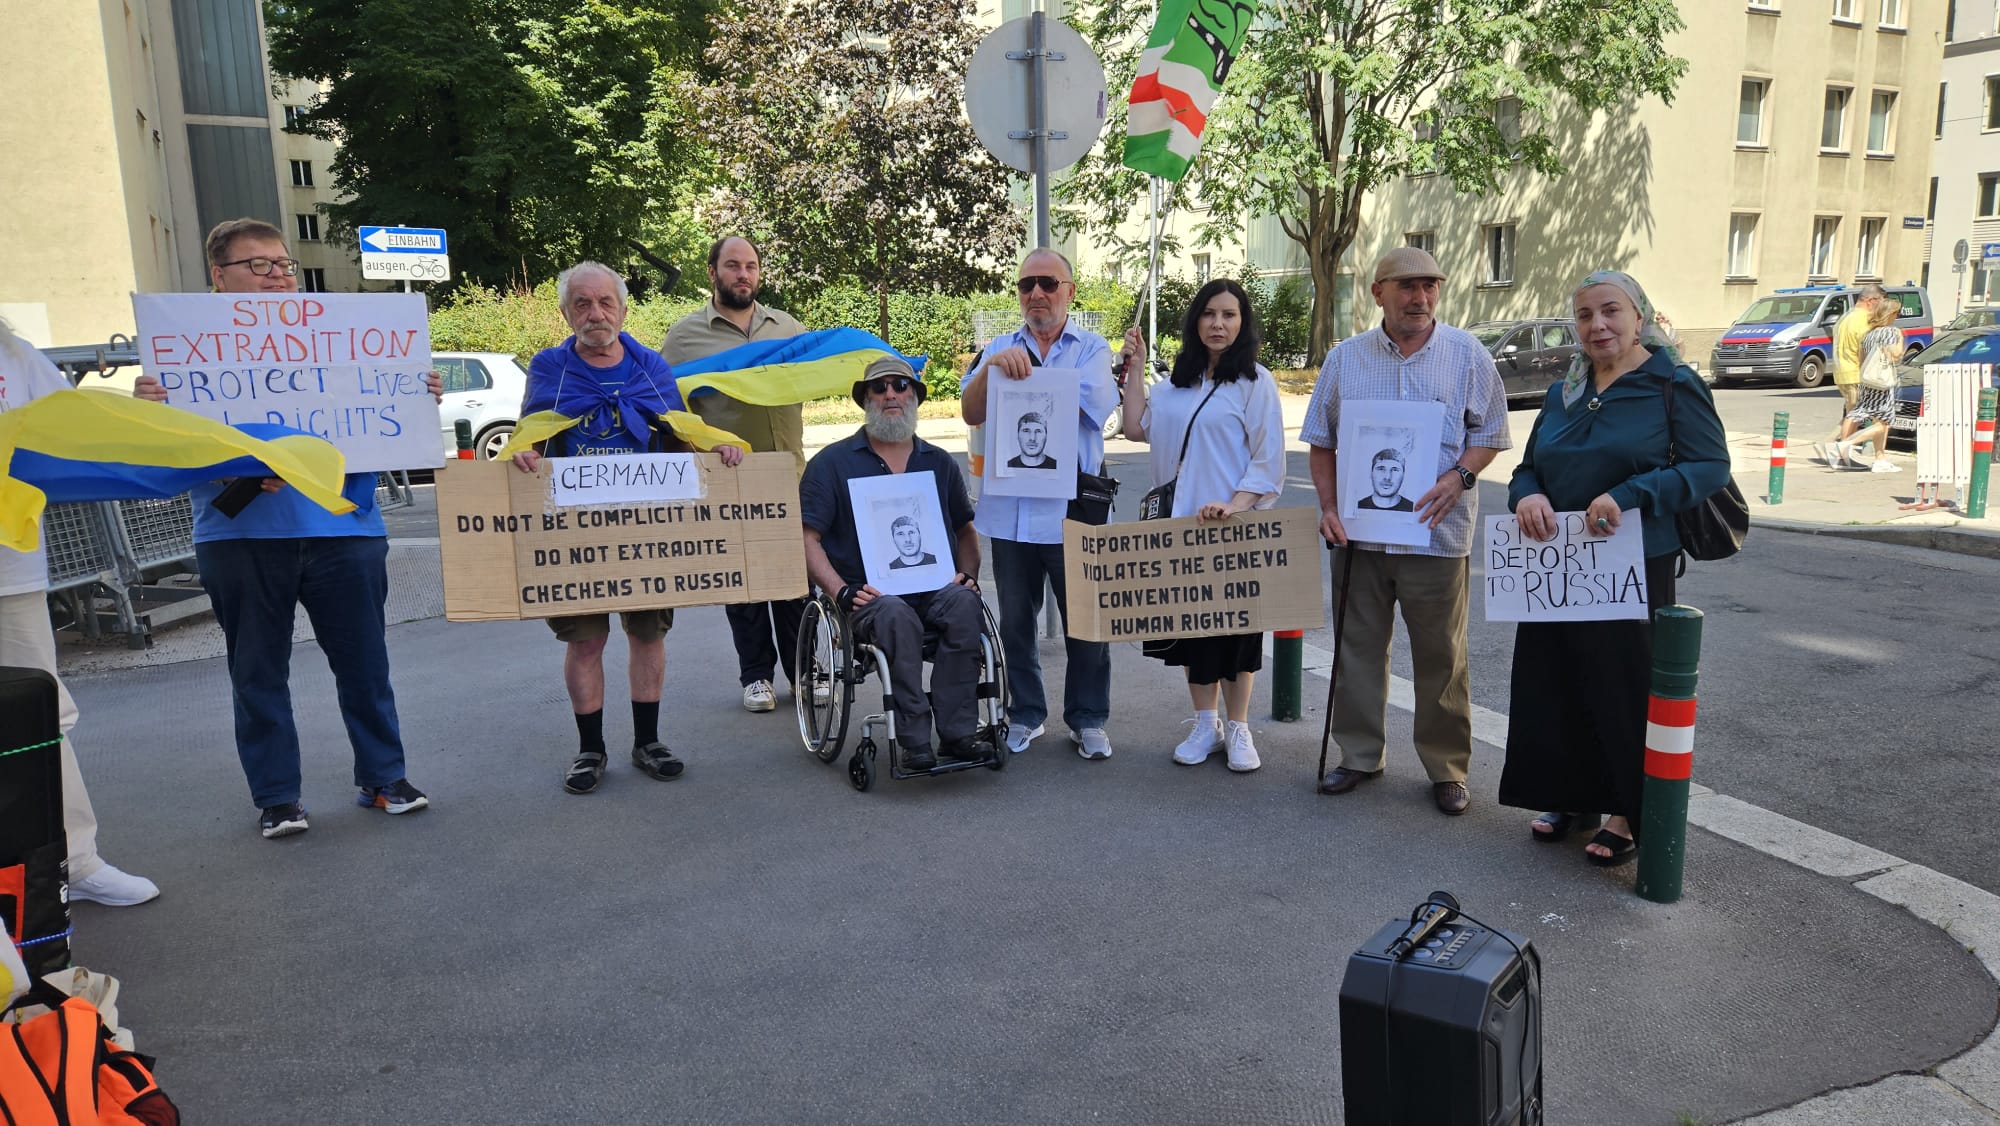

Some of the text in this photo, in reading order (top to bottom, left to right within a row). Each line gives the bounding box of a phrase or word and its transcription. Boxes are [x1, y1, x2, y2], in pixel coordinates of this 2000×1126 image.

[388, 234, 437, 247] EINBAHN
[366, 261, 409, 273] ausgen.
[233, 299, 324, 327] STOP
[561, 461, 689, 491] GERMANY
[457, 502, 788, 533] DO NOT BE COMPLICIT IN CRIMES
[534, 539, 728, 567] DO NOT EXTRADITE
[1081, 521, 1283, 555] DEPORTING CHECHENS
[1082, 548, 1288, 582] VIOLATES THE GENEVA
[1491, 540, 1608, 572] DEPORT
[521, 571, 743, 604] CHECHENS TO RUSSIA
[1098, 580, 1261, 609] CONVENTION AND
[1488, 565, 1648, 613] TO RUSSIA
[1111, 610, 1250, 636] HUMAN RIGHTS
